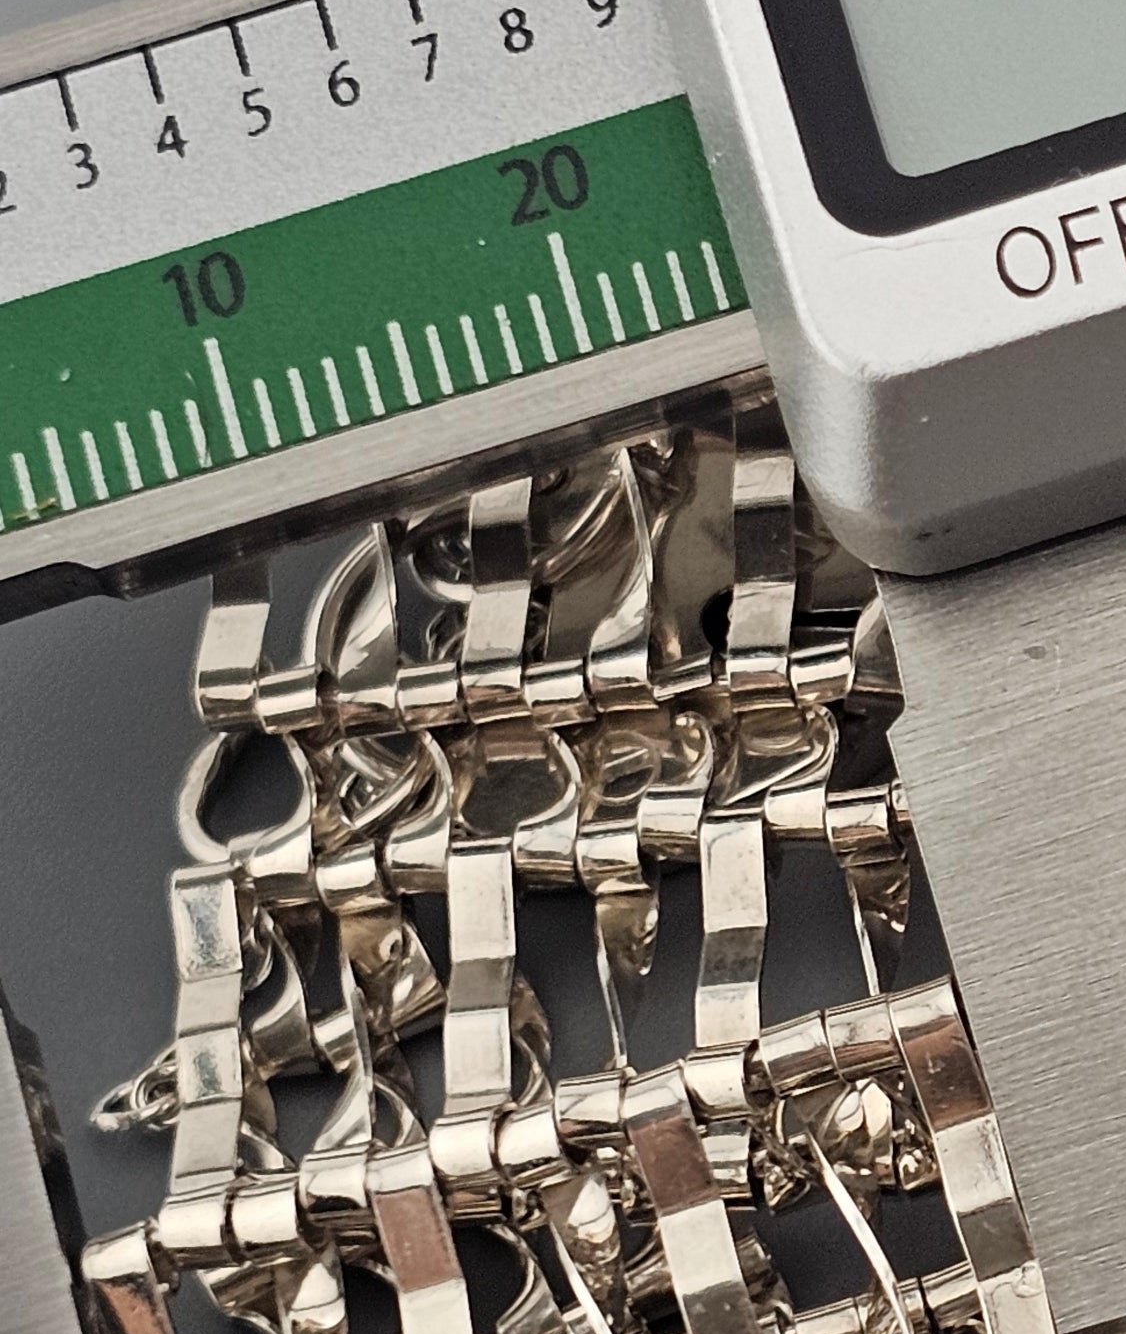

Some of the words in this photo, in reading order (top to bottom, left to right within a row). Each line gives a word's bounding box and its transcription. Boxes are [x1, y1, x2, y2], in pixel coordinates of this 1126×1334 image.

[67, 142, 100, 189] 3
[156, 115, 188, 159] 4
[242, 88, 272, 137] 5
[327, 61, 361, 107] 6
[411, 33, 439, 82] 7
[499, 8, 534, 54] 8
[162, 252, 246, 327] 10
[499, 144, 590, 227] 20
